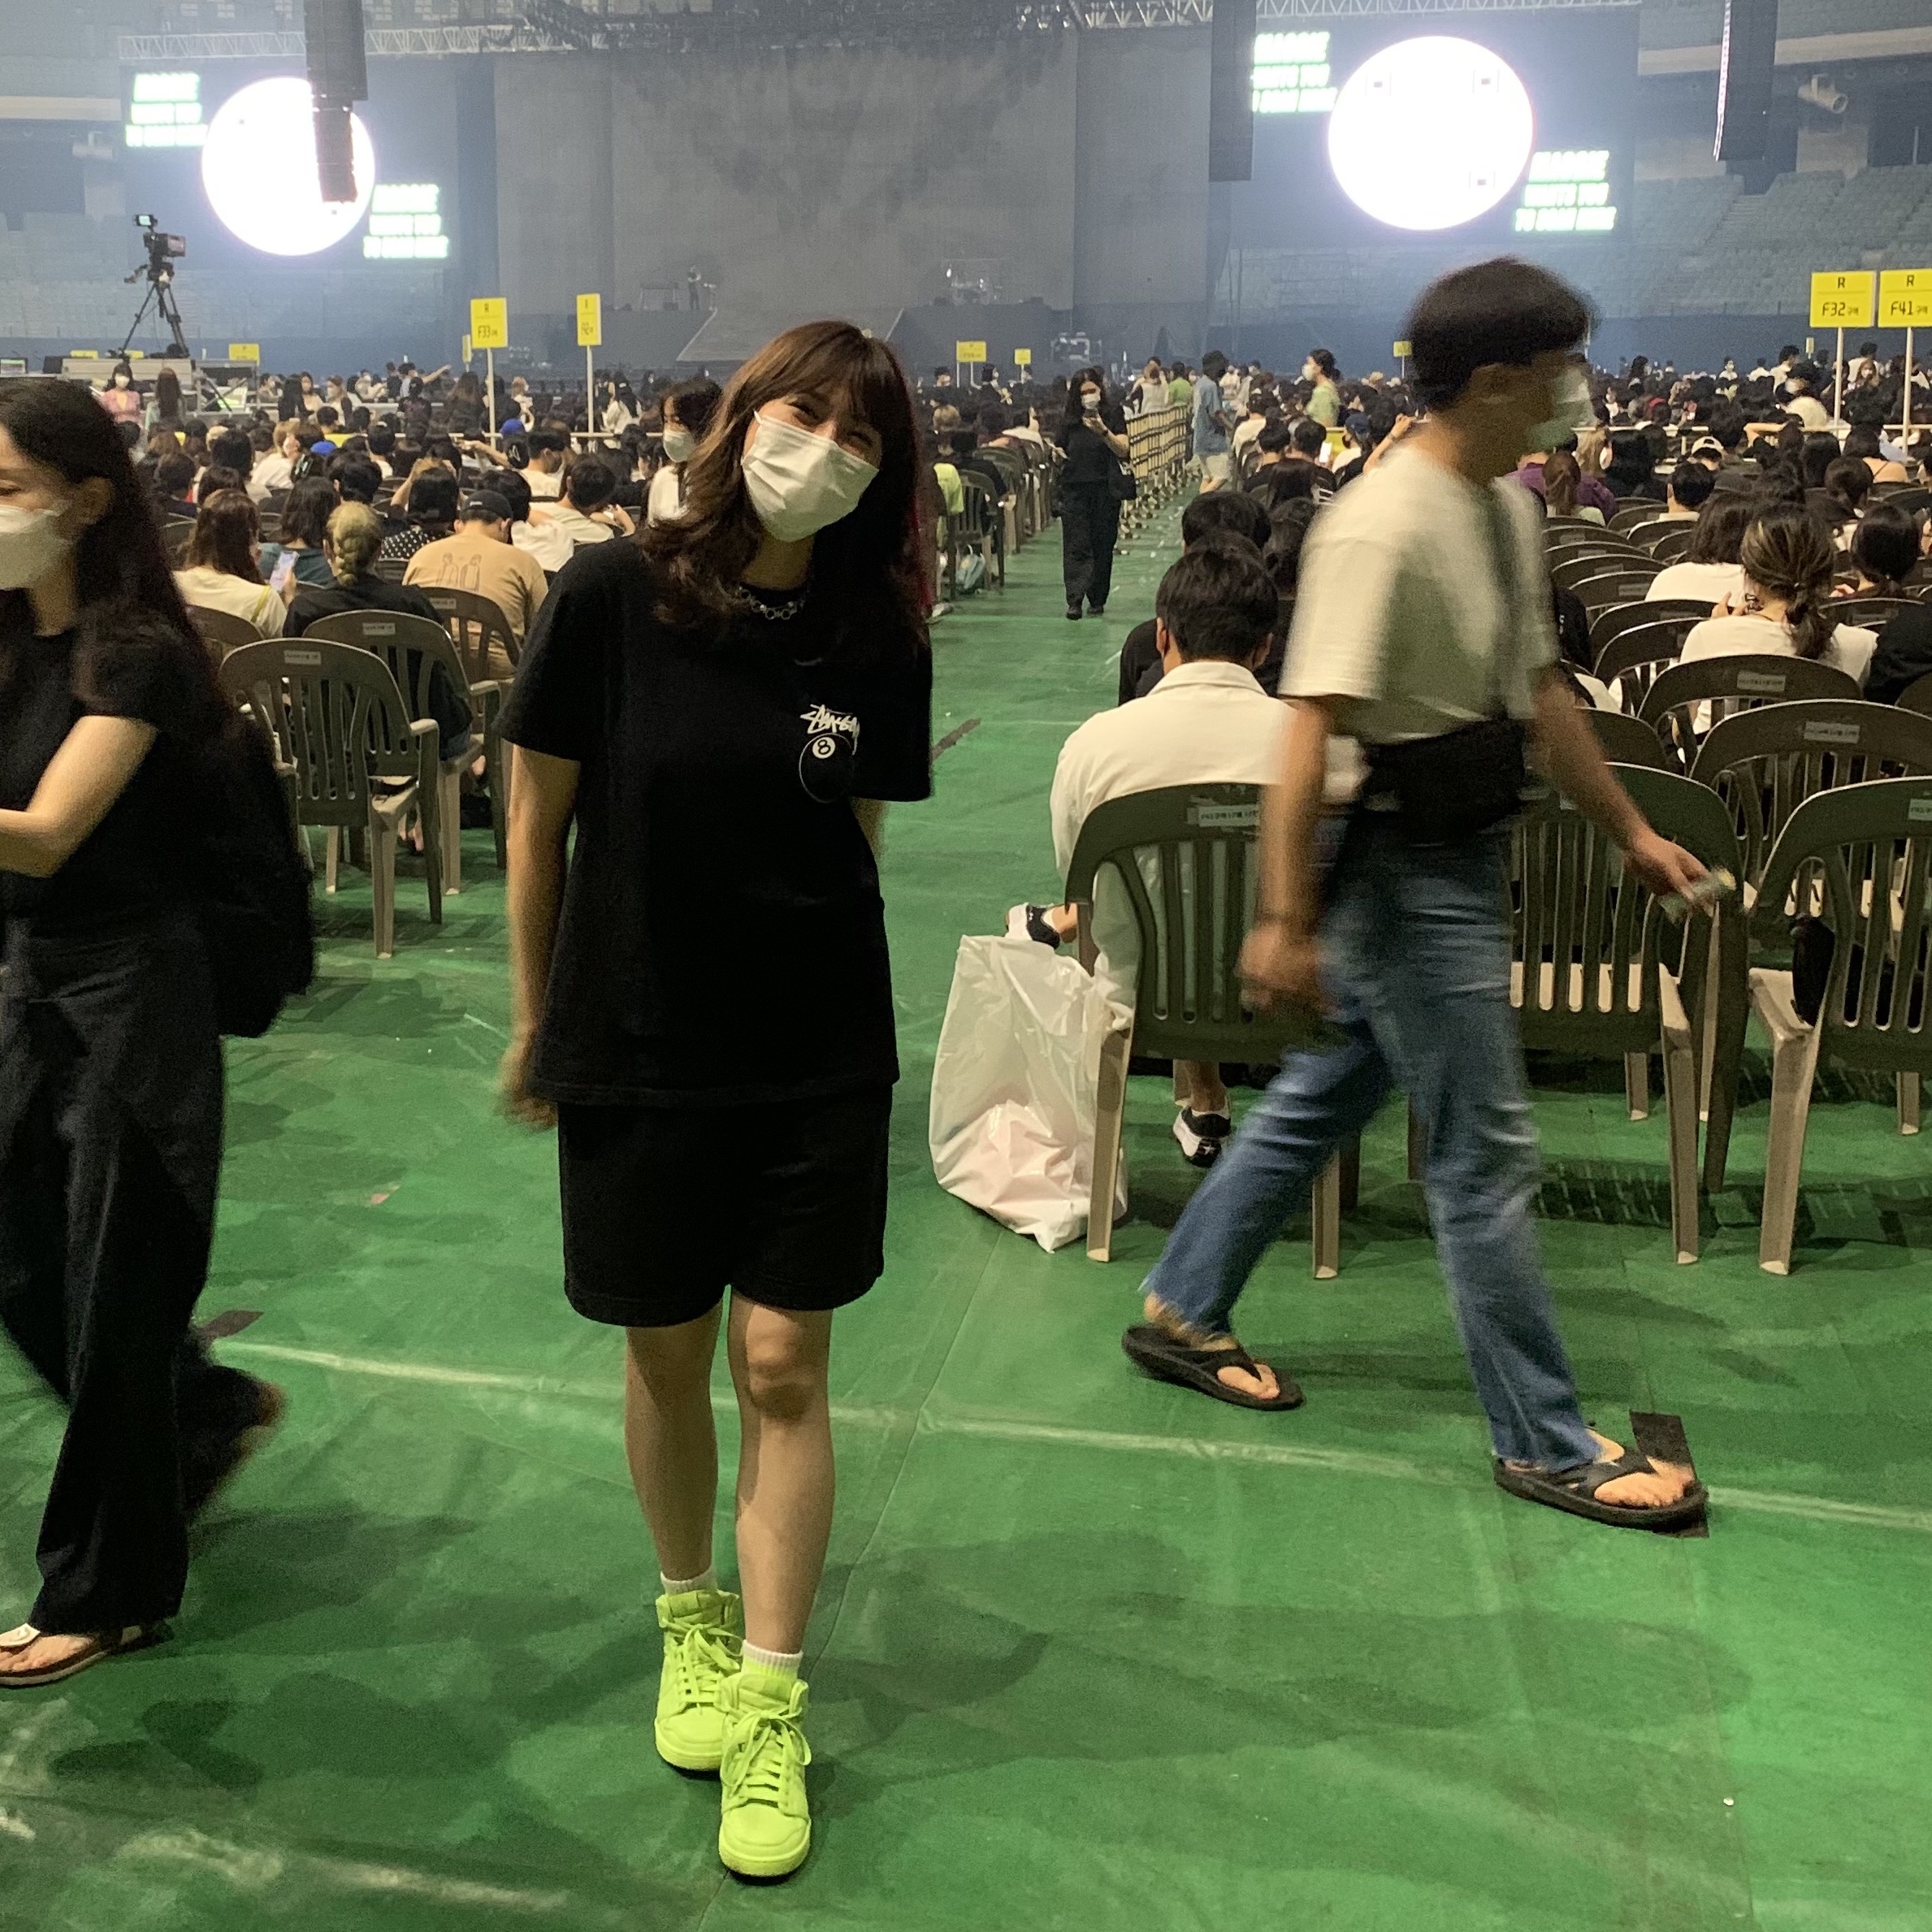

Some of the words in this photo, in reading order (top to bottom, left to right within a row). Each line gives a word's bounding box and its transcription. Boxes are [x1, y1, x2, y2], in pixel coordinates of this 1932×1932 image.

[1838, 277, 1846, 288] R
[1907, 275, 1915, 286] R
[817, 739, 831, 755] 8
